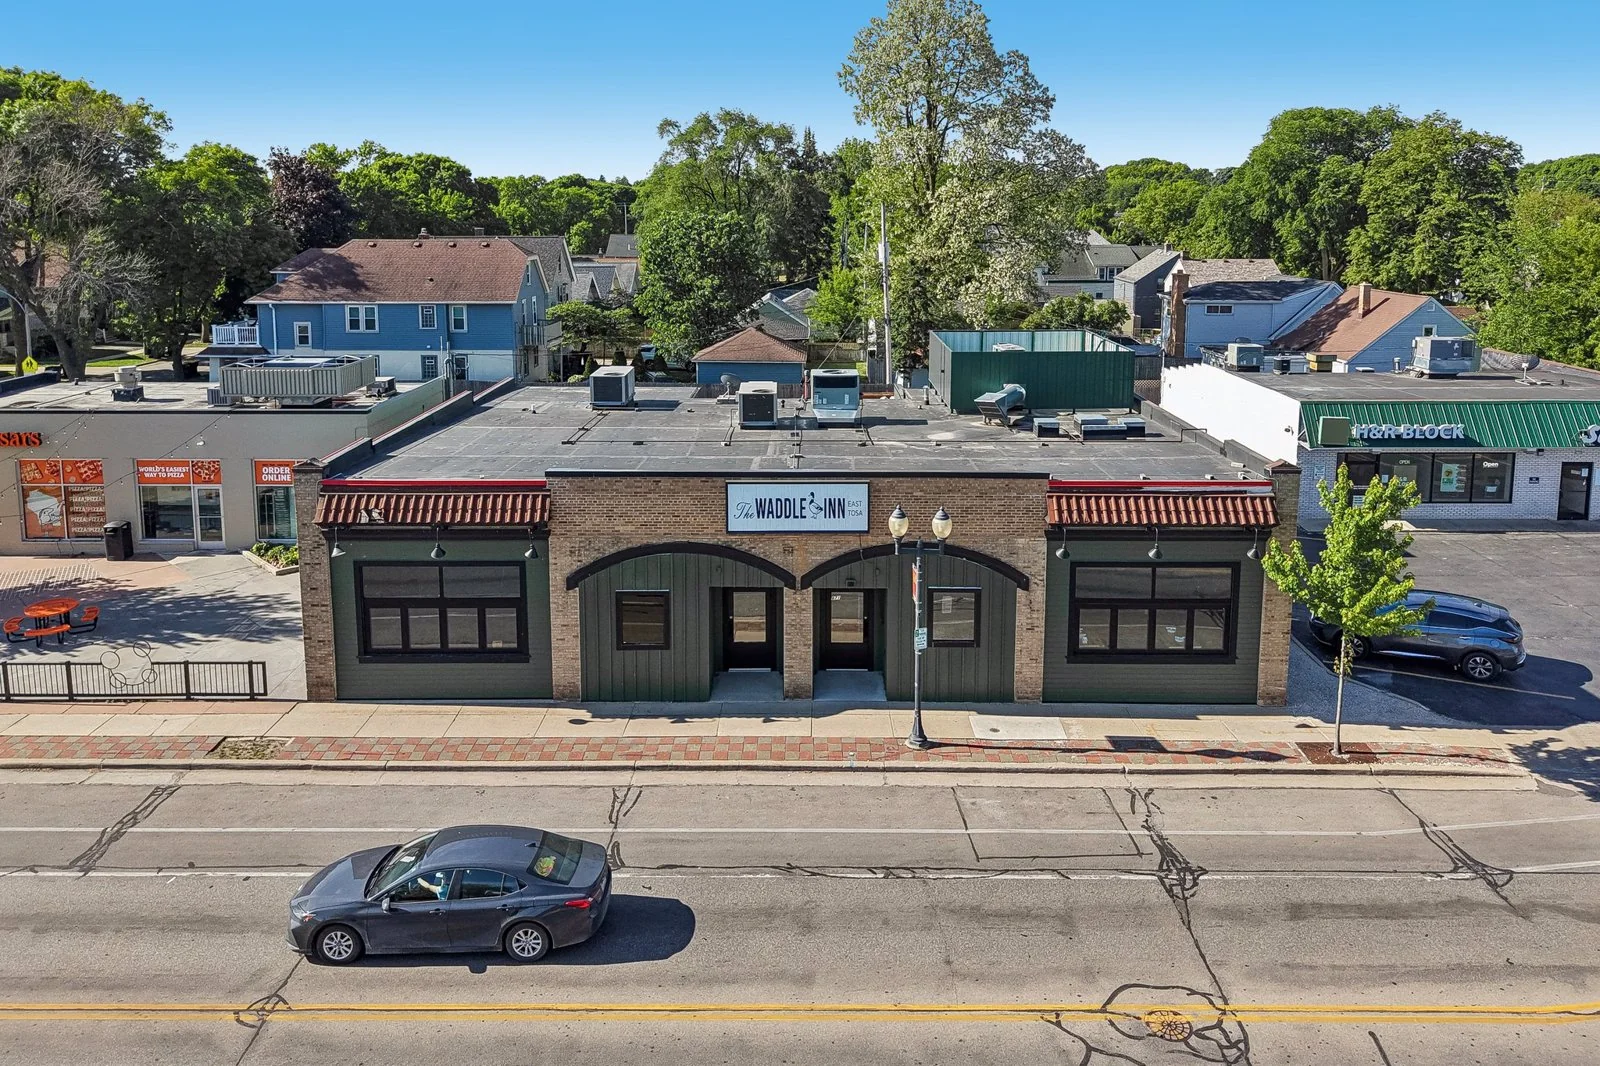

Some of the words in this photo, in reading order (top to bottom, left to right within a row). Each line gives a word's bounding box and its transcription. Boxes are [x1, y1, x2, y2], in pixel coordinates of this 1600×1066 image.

[1355, 424, 1396, 439] H&R
[1401, 424, 1465, 439] BLOCK
[138, 465, 165, 473] WORLD'S
[262, 466, 290, 474] ORDER
[734, 501, 755, 519] The
[755, 497, 807, 519] WADDLE
[824, 497, 846, 519] INN
[848, 509, 863, 517] TOSA
